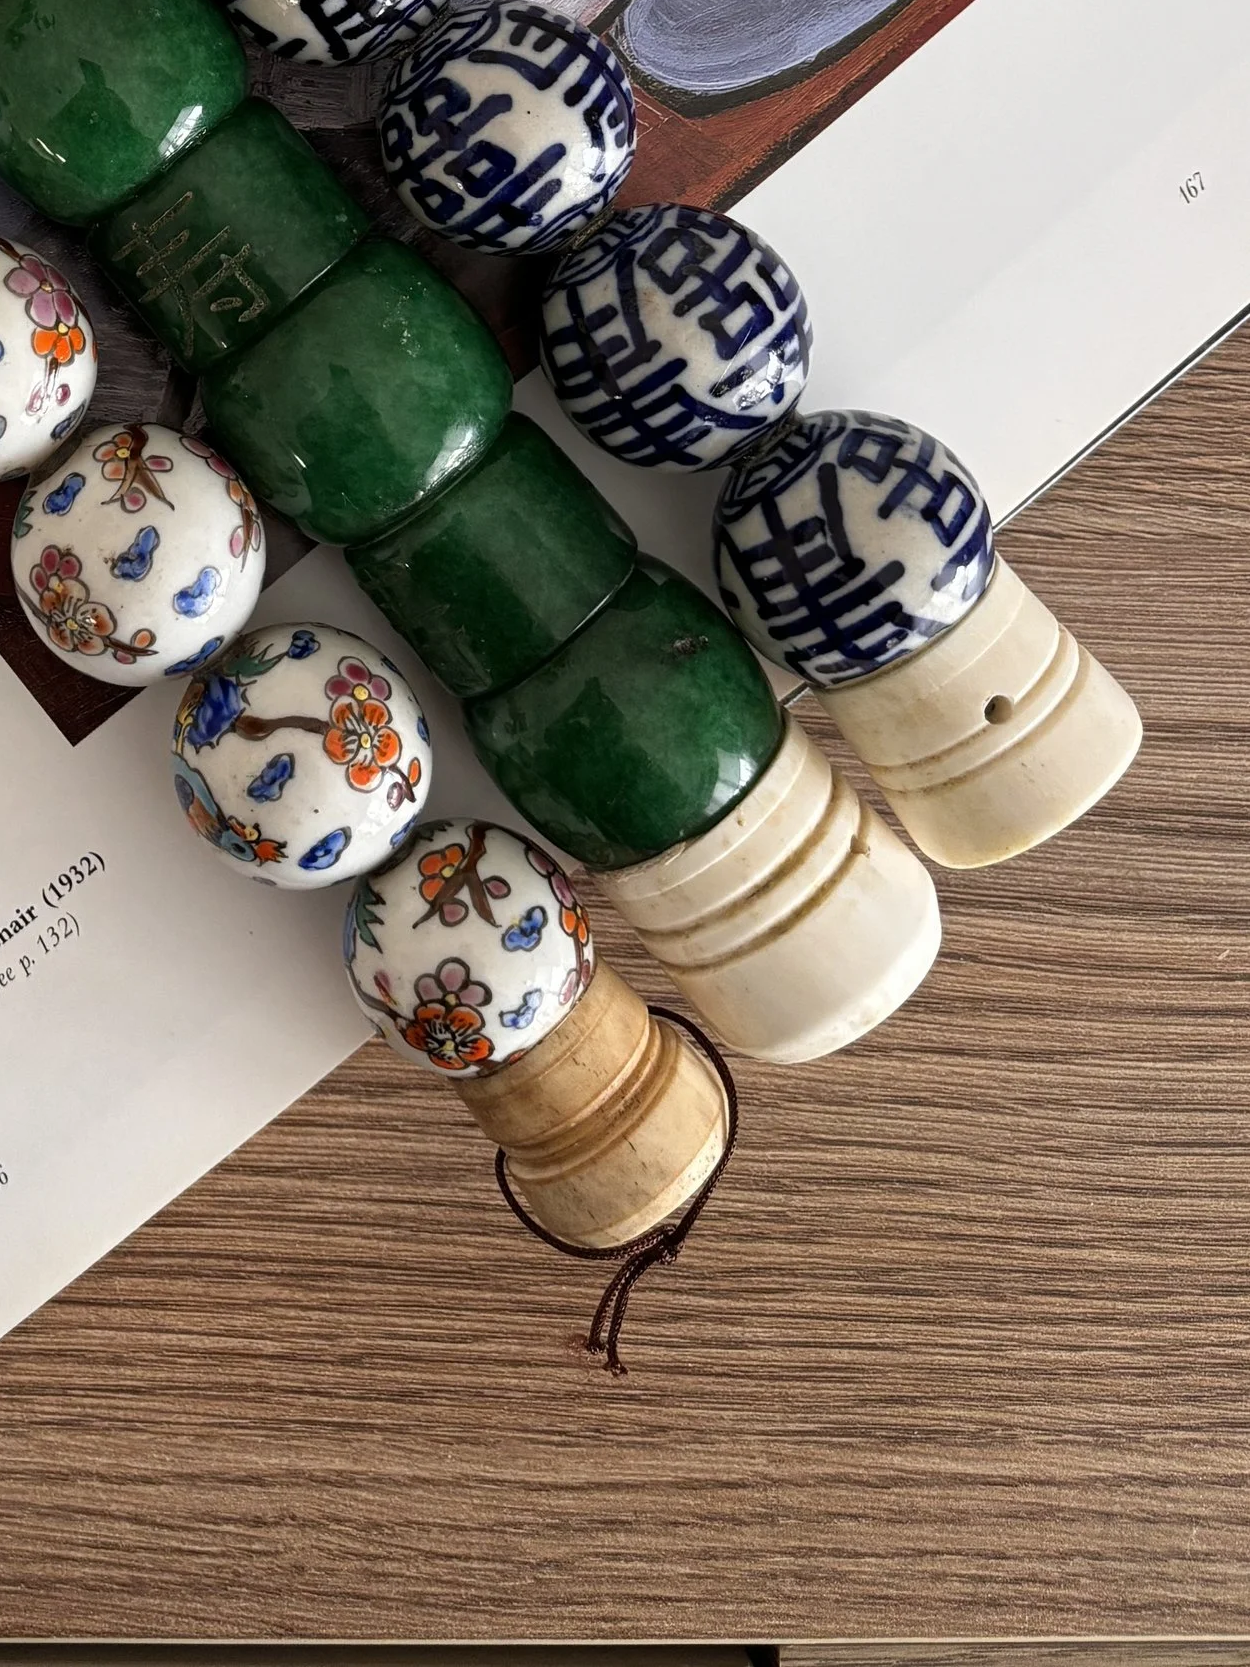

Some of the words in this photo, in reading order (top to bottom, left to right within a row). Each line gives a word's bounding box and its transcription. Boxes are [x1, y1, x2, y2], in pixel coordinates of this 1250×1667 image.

[1178, 171, 1205, 204] 167
[41, 851, 106, 909] (1932)
[18, 954, 36, 978] p.
[36, 911, 80, 955] 132)
